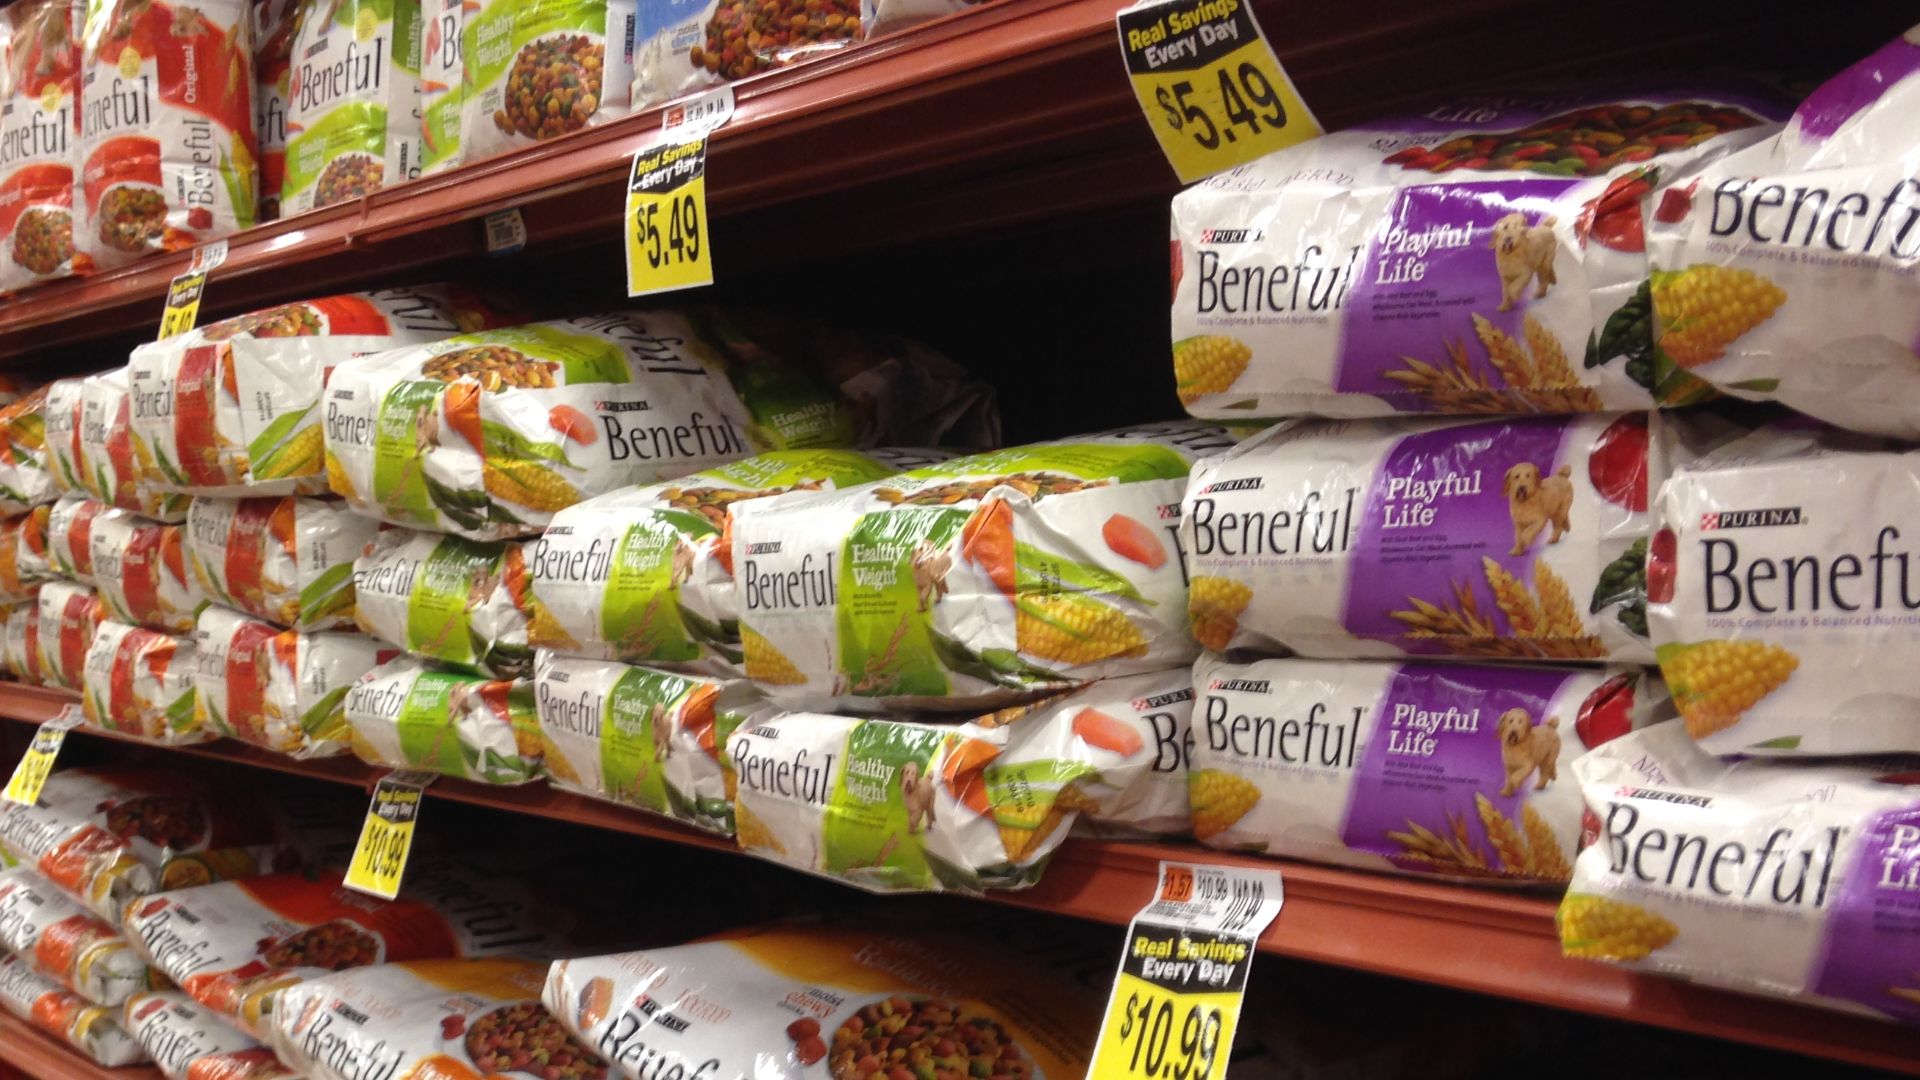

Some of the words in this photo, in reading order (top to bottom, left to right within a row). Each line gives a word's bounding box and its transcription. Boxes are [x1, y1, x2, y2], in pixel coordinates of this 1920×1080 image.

[1128, 19, 1167, 51] Real
[1168, 0, 1239, 36] Savings
[1144, 34, 1198, 69] Every
[1199, 18, 1239, 48] Day
[182, 45, 196, 103] Original
[301, 37, 383, 112] Beneful
[84, 75, 151, 137] eneful
[1155, 62, 1288, 150] $5.49
[0, 109, 67, 164] eneful
[183, 118, 214, 205] Beneful
[637, 154, 660, 177] Real
[661, 139, 703, 167] Savings
[641, 160, 676, 189] Every
[675, 160, 696, 180] Day
[637, 194, 700, 270] $5.49
[1213, 229, 1262, 243] PURI
[1381, 220, 1474, 258] Playful
[1197, 245, 1361, 314] Beneful
[1375, 256, 1426, 285] Life
[771, 402, 836, 428] Healthy
[778, 415, 838, 438] Weight
[599, 411, 742, 460] Beneful
[1210, 477, 1262, 493] PURINA
[1387, 470, 1482, 504] Playful
[1193, 487, 1356, 555] Beneful
[1381, 503, 1436, 529] Life
[1720, 508, 1799, 528] PURINA
[534, 537, 618, 581] Beneful
[628, 532, 672, 553] Healthy
[852, 543, 906, 566] Healthy
[623, 551, 661, 575] Weight
[745, 551, 835, 610] Beneful
[852, 566, 898, 591] Weight
[1738, 616, 1795, 631] Complete
[1801, 616, 1809, 627] &
[1812, 614, 1871, 627] Balanced
[1147, 688, 1194, 708] PURI
[1219, 679, 1270, 694] PURINA
[540, 682, 603, 738] Beneful
[1391, 702, 1481, 734] Playful
[1206, 695, 1364, 769] Beneful
[1387, 729, 1438, 757] Life
[734, 738, 832, 805] Beneful
[846, 753, 896, 785] Healthy
[364, 823, 406, 880] $10.99
[1605, 801, 1842, 907] Beneful
[1198, 875, 1228, 901] $10.99
[140, 910, 223, 983] Beneful
[1134, 936, 1173, 958] Real
[1178, 937, 1247, 964] Savings
[1141, 957, 1195, 985] Every
[1197, 959, 1236, 987] Day
[785, 991, 838, 1019] chewy
[810, 987, 846, 1006] moist
[138, 1010, 220, 1073] Beneful
[1120, 990, 1222, 1080] $10.99
